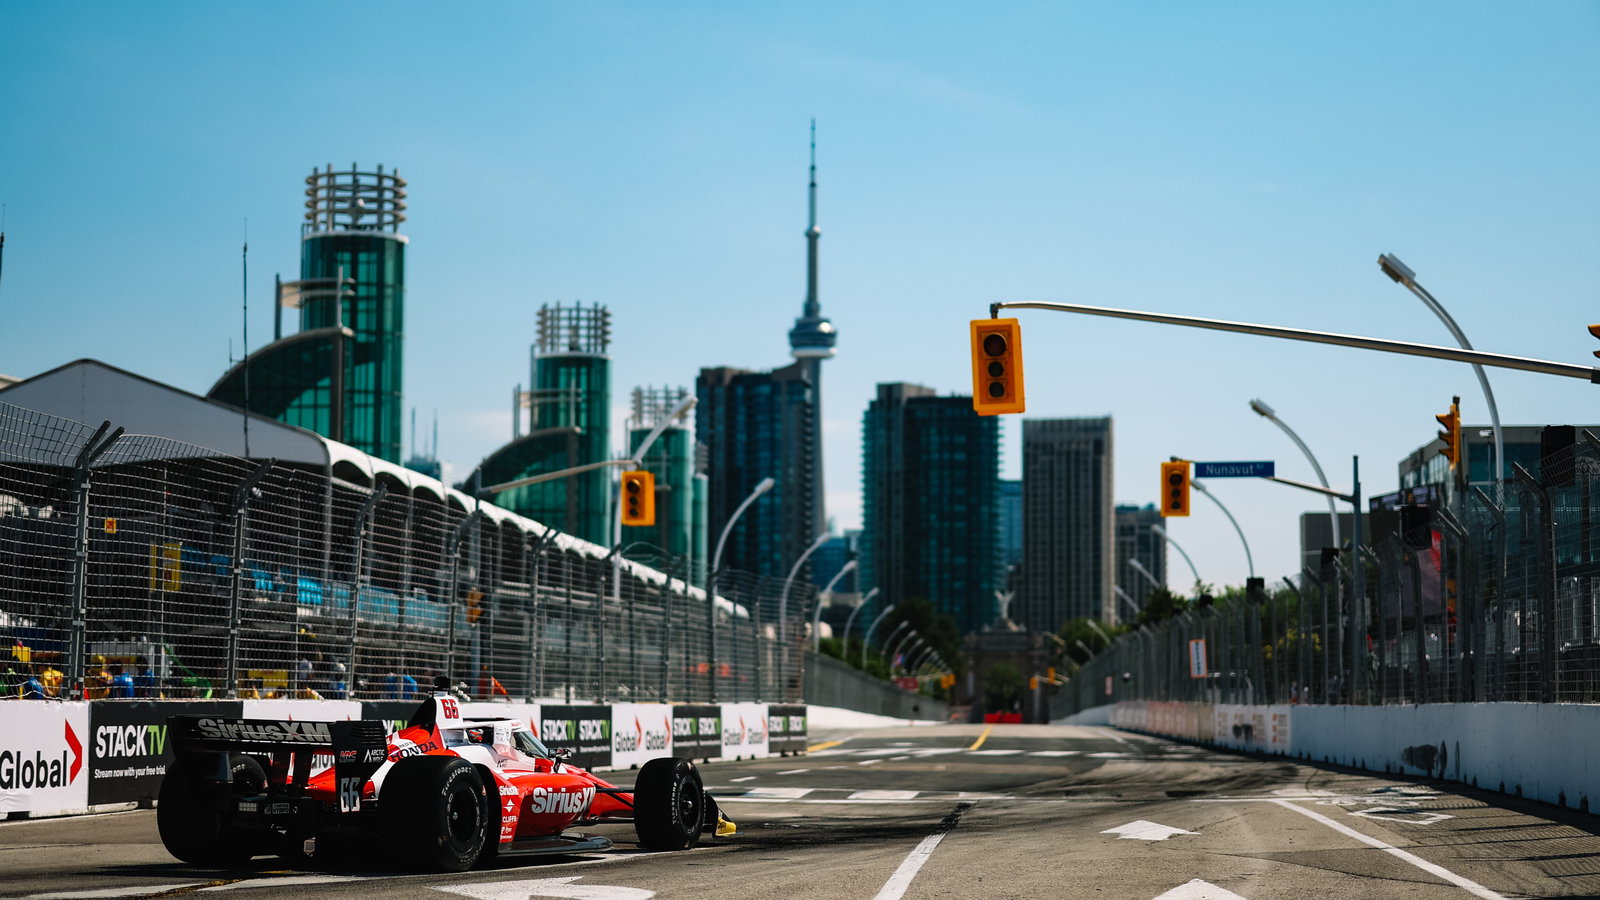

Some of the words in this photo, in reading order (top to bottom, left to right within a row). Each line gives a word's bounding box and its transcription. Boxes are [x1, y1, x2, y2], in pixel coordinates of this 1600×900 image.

[1206, 464, 1254, 475] Nunavut
[441, 699, 459, 719] 66
[198, 718, 332, 743] SiriusXM
[95, 724, 167, 759] STACKTV
[390, 741, 438, 762] HONDA
[0, 750, 67, 790] Global
[94, 768, 113, 779] Stream
[113, 769, 124, 777] now
[124, 766, 135, 776] with
[135, 768, 146, 779] your
[145, 765, 155, 775] free
[156, 765, 166, 775] trial
[341, 777, 360, 813] 66
[502, 815, 517, 823] CLIFFS
